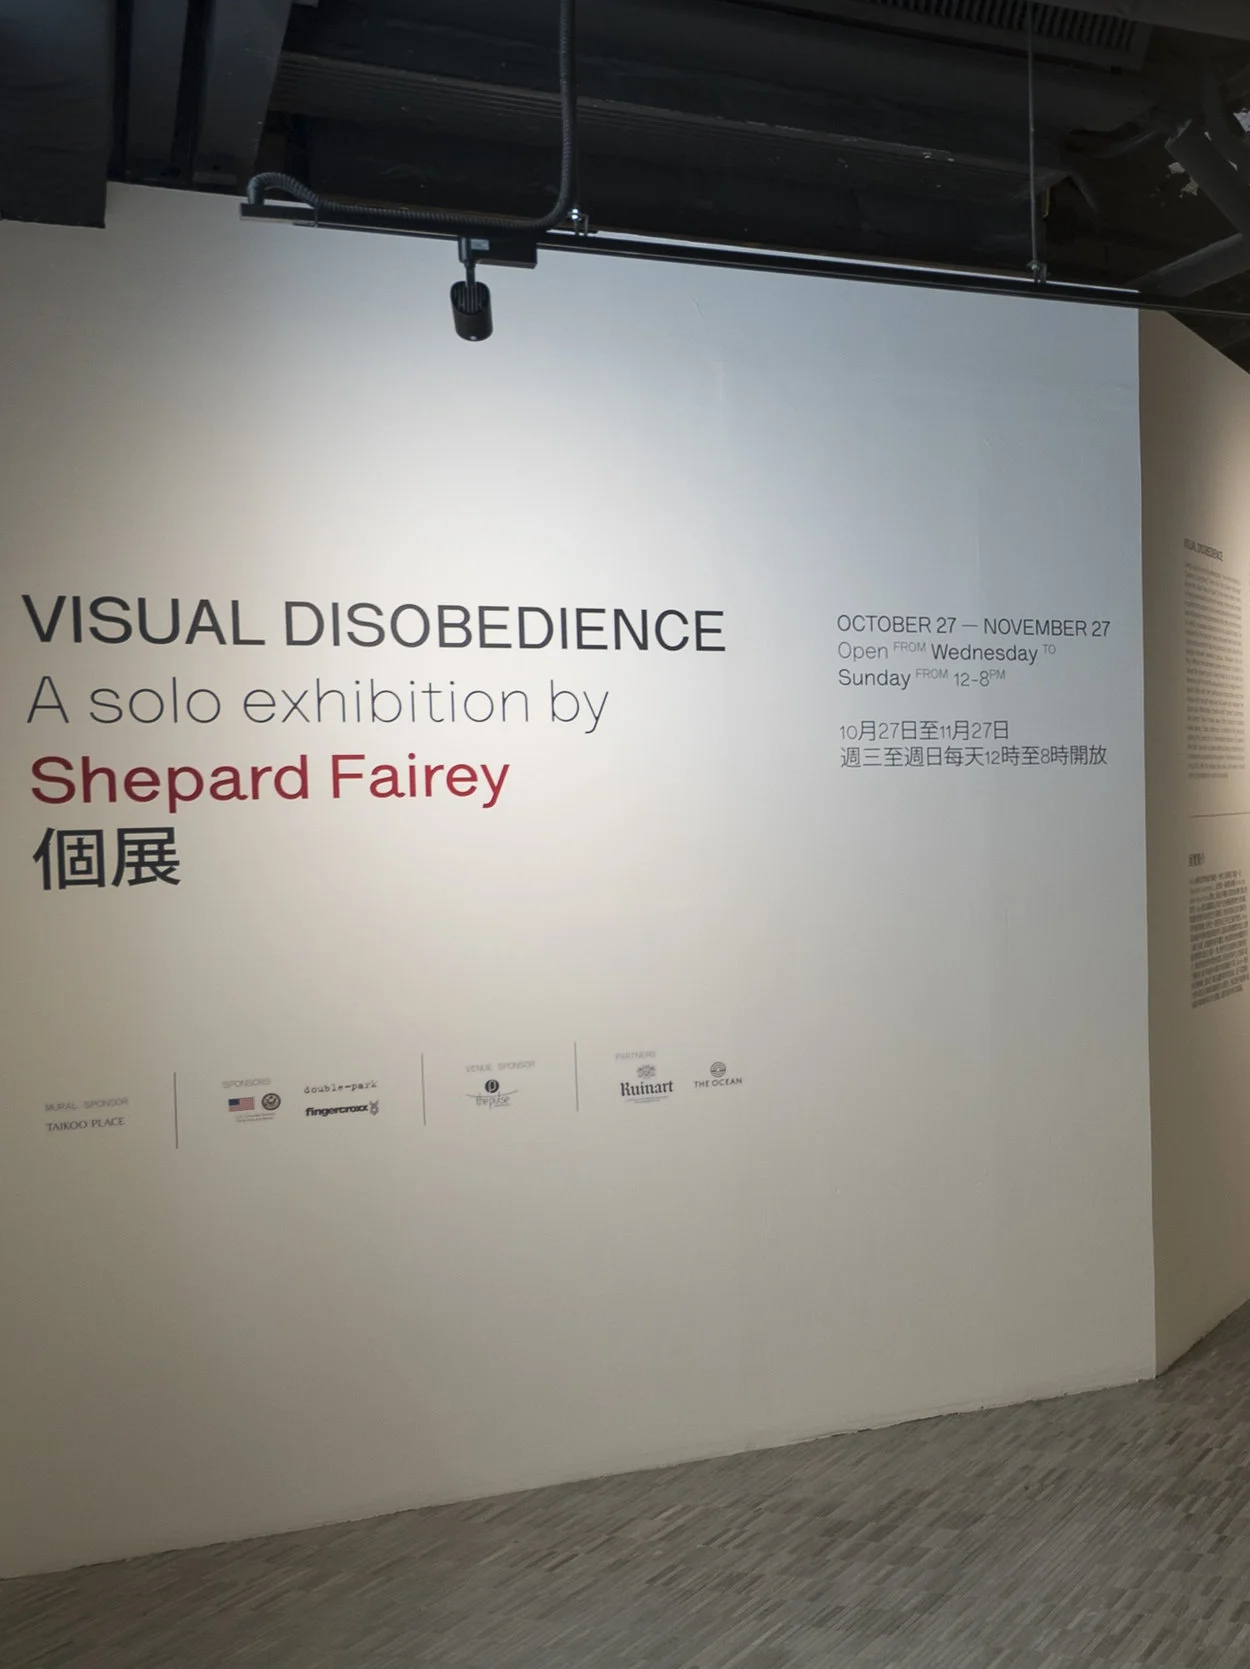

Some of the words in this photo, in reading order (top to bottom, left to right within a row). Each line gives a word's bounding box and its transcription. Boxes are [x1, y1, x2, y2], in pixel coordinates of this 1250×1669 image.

[22, 594, 265, 646] VISUAL
[284, 601, 727, 652] DISOBEDIENCE
[837, 614, 931, 633] OCTOBER
[936, 616, 956, 634] 27
[983, 618, 1087, 637] NOVEMBER
[1091, 620, 1111, 637] 27
[838, 641, 889, 662] Open
[893, 641, 926, 653] FROM
[931, 643, 1038, 665] Wednesday
[1043, 644, 1056, 655] TO
[838, 669, 911, 690] Sunday
[915, 668, 948, 680] FROM
[27, 676, 69, 724] A
[89, 677, 221, 725] solo
[242, 678, 530, 724] exhibition
[550, 679, 610, 733] by
[839, 720, 1009, 741] 10月27日至11月27日
[840, 745, 1108, 768] 週三至週日每天12時至8時開放
[30, 754, 310, 814] Shepard
[331, 753, 511, 809] Fairey
[32, 826, 182, 891] 個展
[465, 1063, 492, 1073] VENUE
[497, 1060, 535, 1071] SPONSOR
[304, 1080, 377, 1094] double-park
[620, 1080, 674, 1097] Ruinart
[694, 1080, 709, 1088] THE
[711, 1077, 743, 1087] OCEAN
[46, 1120, 87, 1131] TAIKOO
[91, 1117, 125, 1128] PLACE
